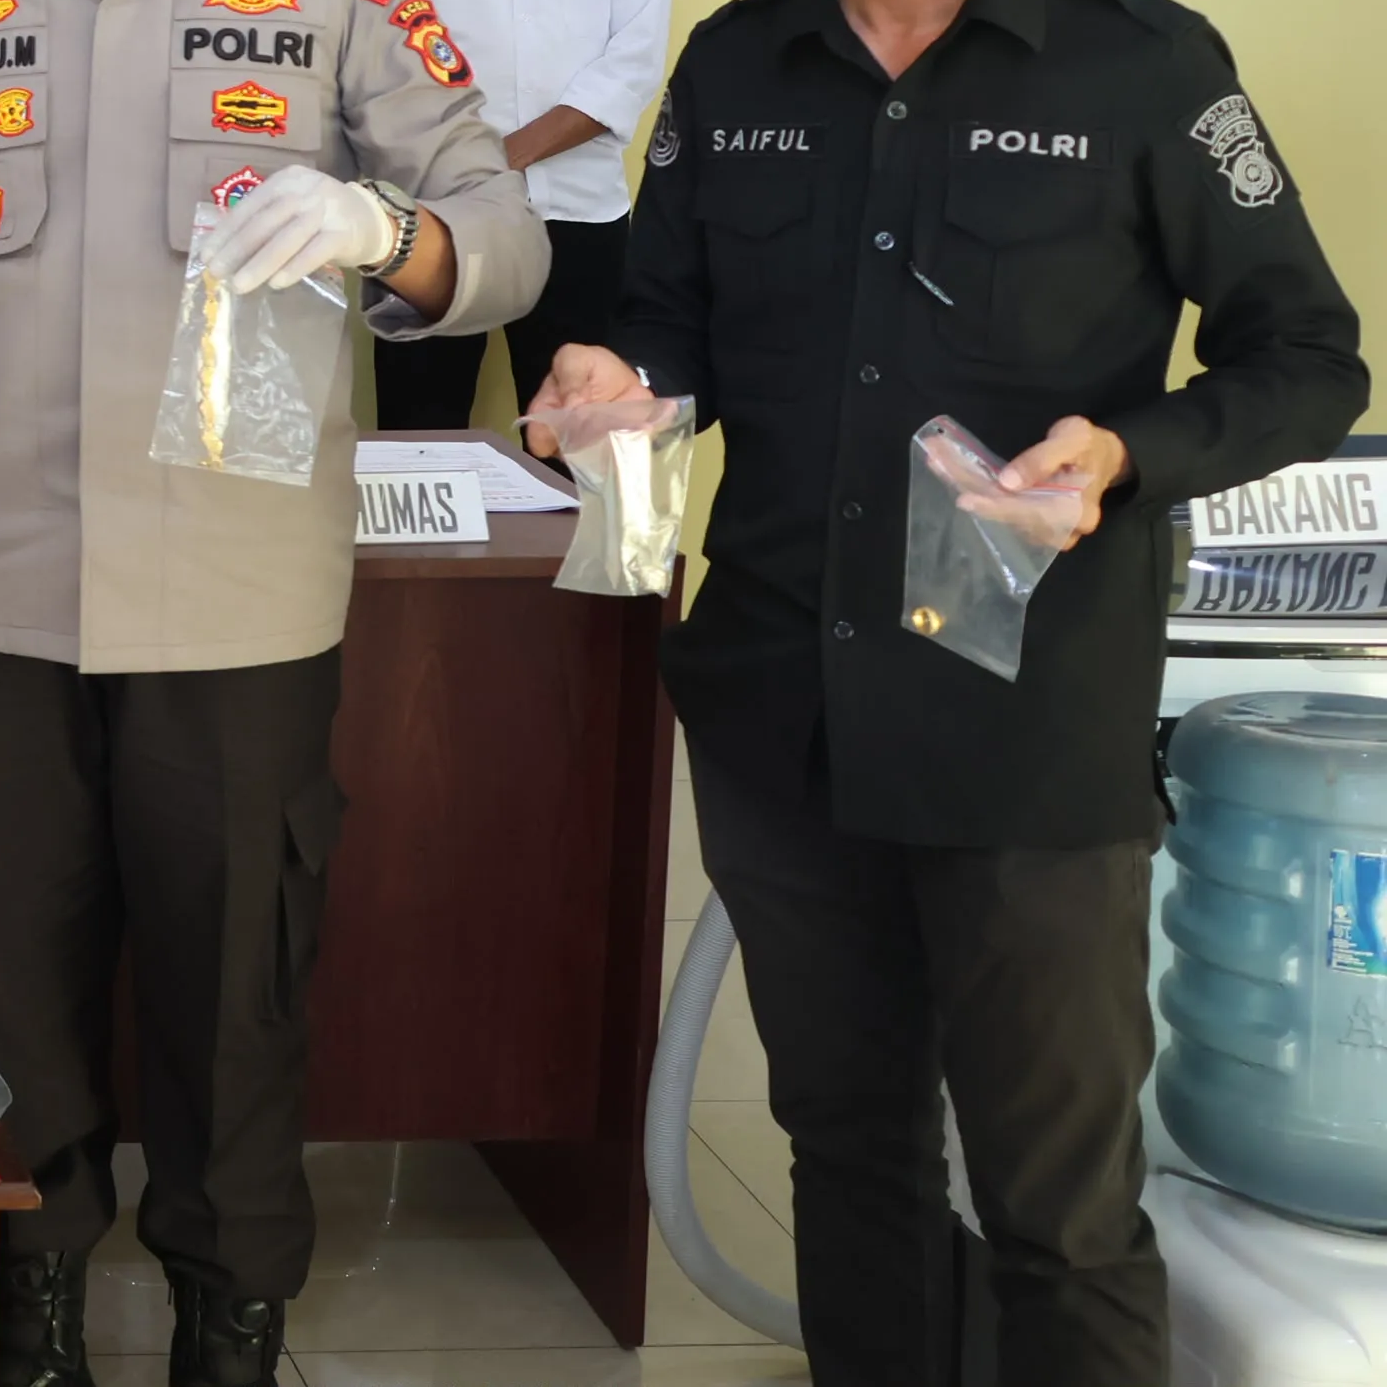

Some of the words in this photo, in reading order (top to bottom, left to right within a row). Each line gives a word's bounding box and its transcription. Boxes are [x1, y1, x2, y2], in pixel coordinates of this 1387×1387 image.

[183, 27, 314, 69] POLRI
[712, 129, 811, 152] SAIFUL
[969, 129, 1089, 160] POLRI
[1206, 473, 1378, 536] BARANG
